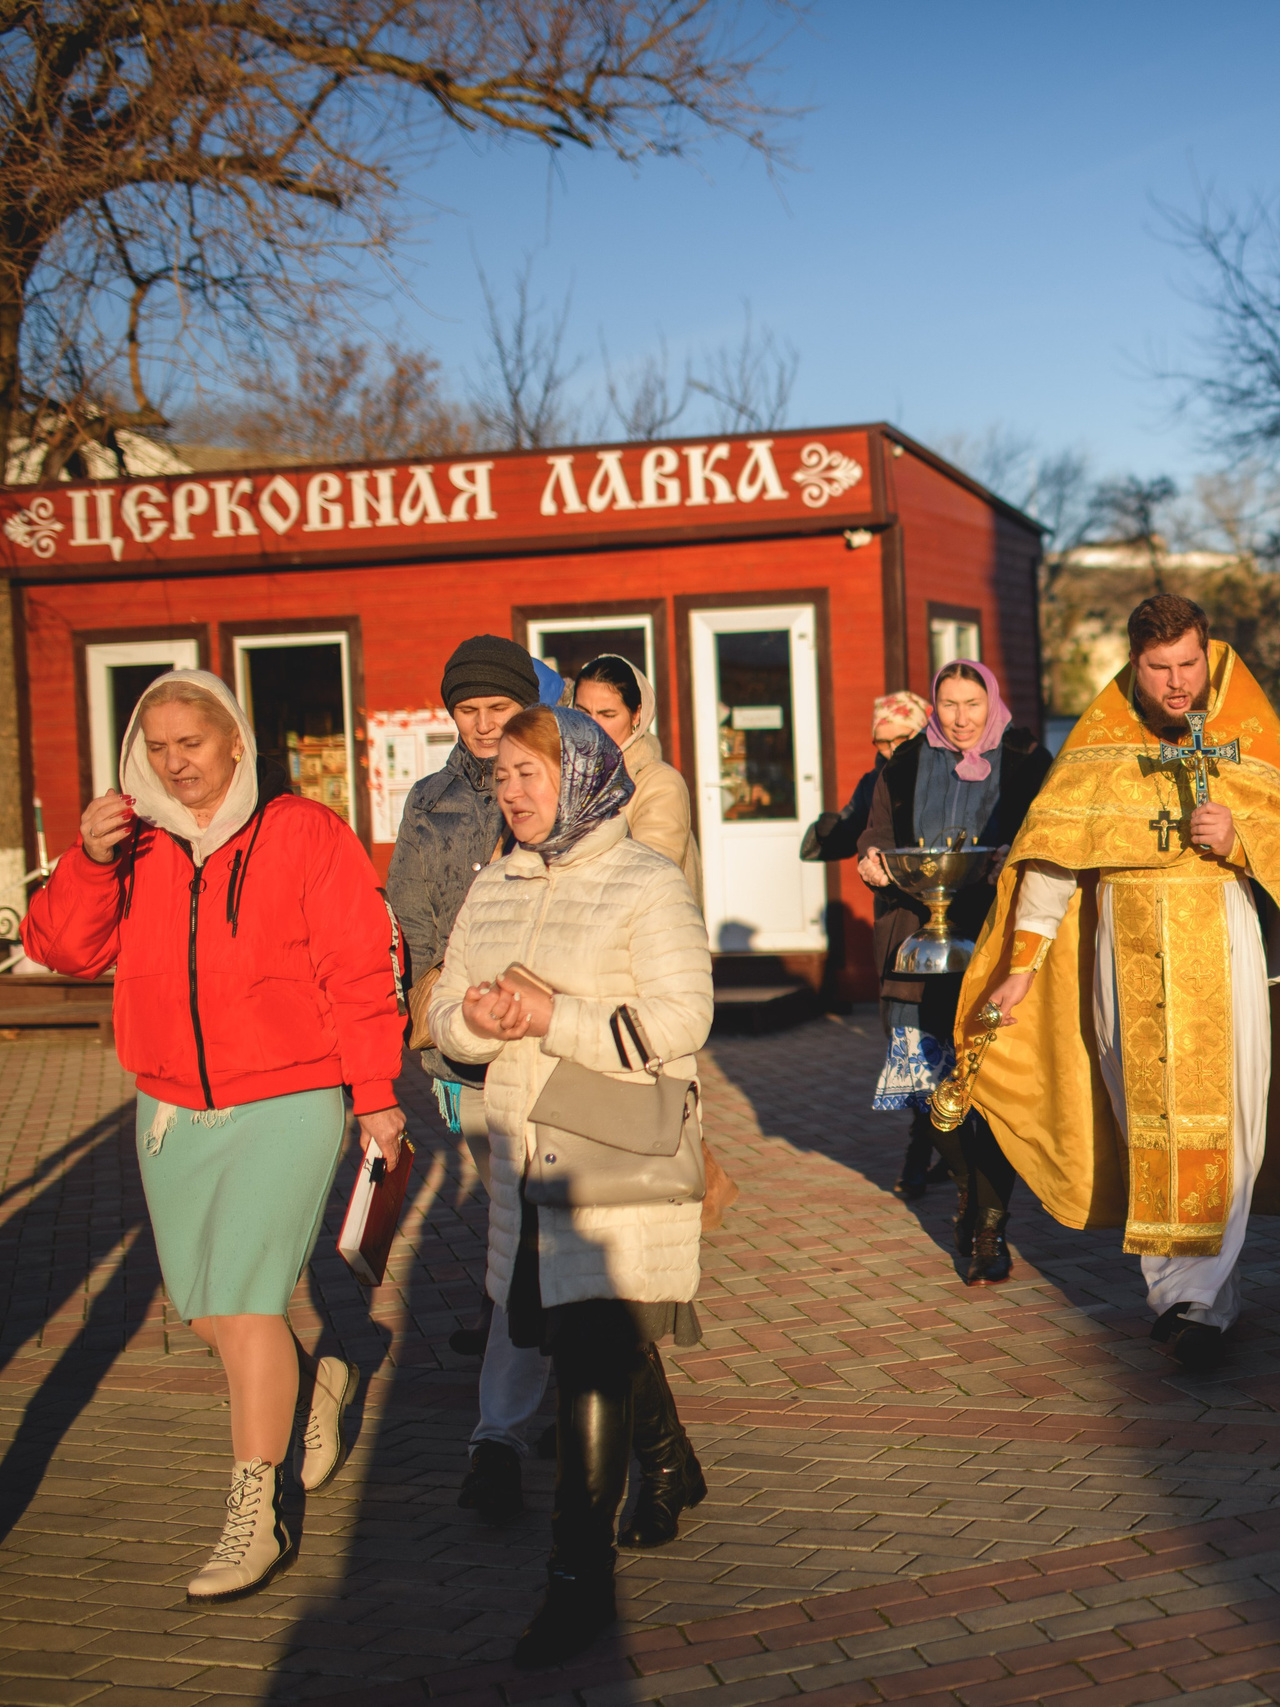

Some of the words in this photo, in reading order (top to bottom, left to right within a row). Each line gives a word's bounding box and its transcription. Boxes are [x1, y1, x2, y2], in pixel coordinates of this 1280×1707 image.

[66, 461, 498, 561] ЦЕРКОВНАЯ
[540, 440, 789, 516] ЛАВКА
[384, 900, 400, 948] RELAX
[390, 952, 405, 1002] RELAX
